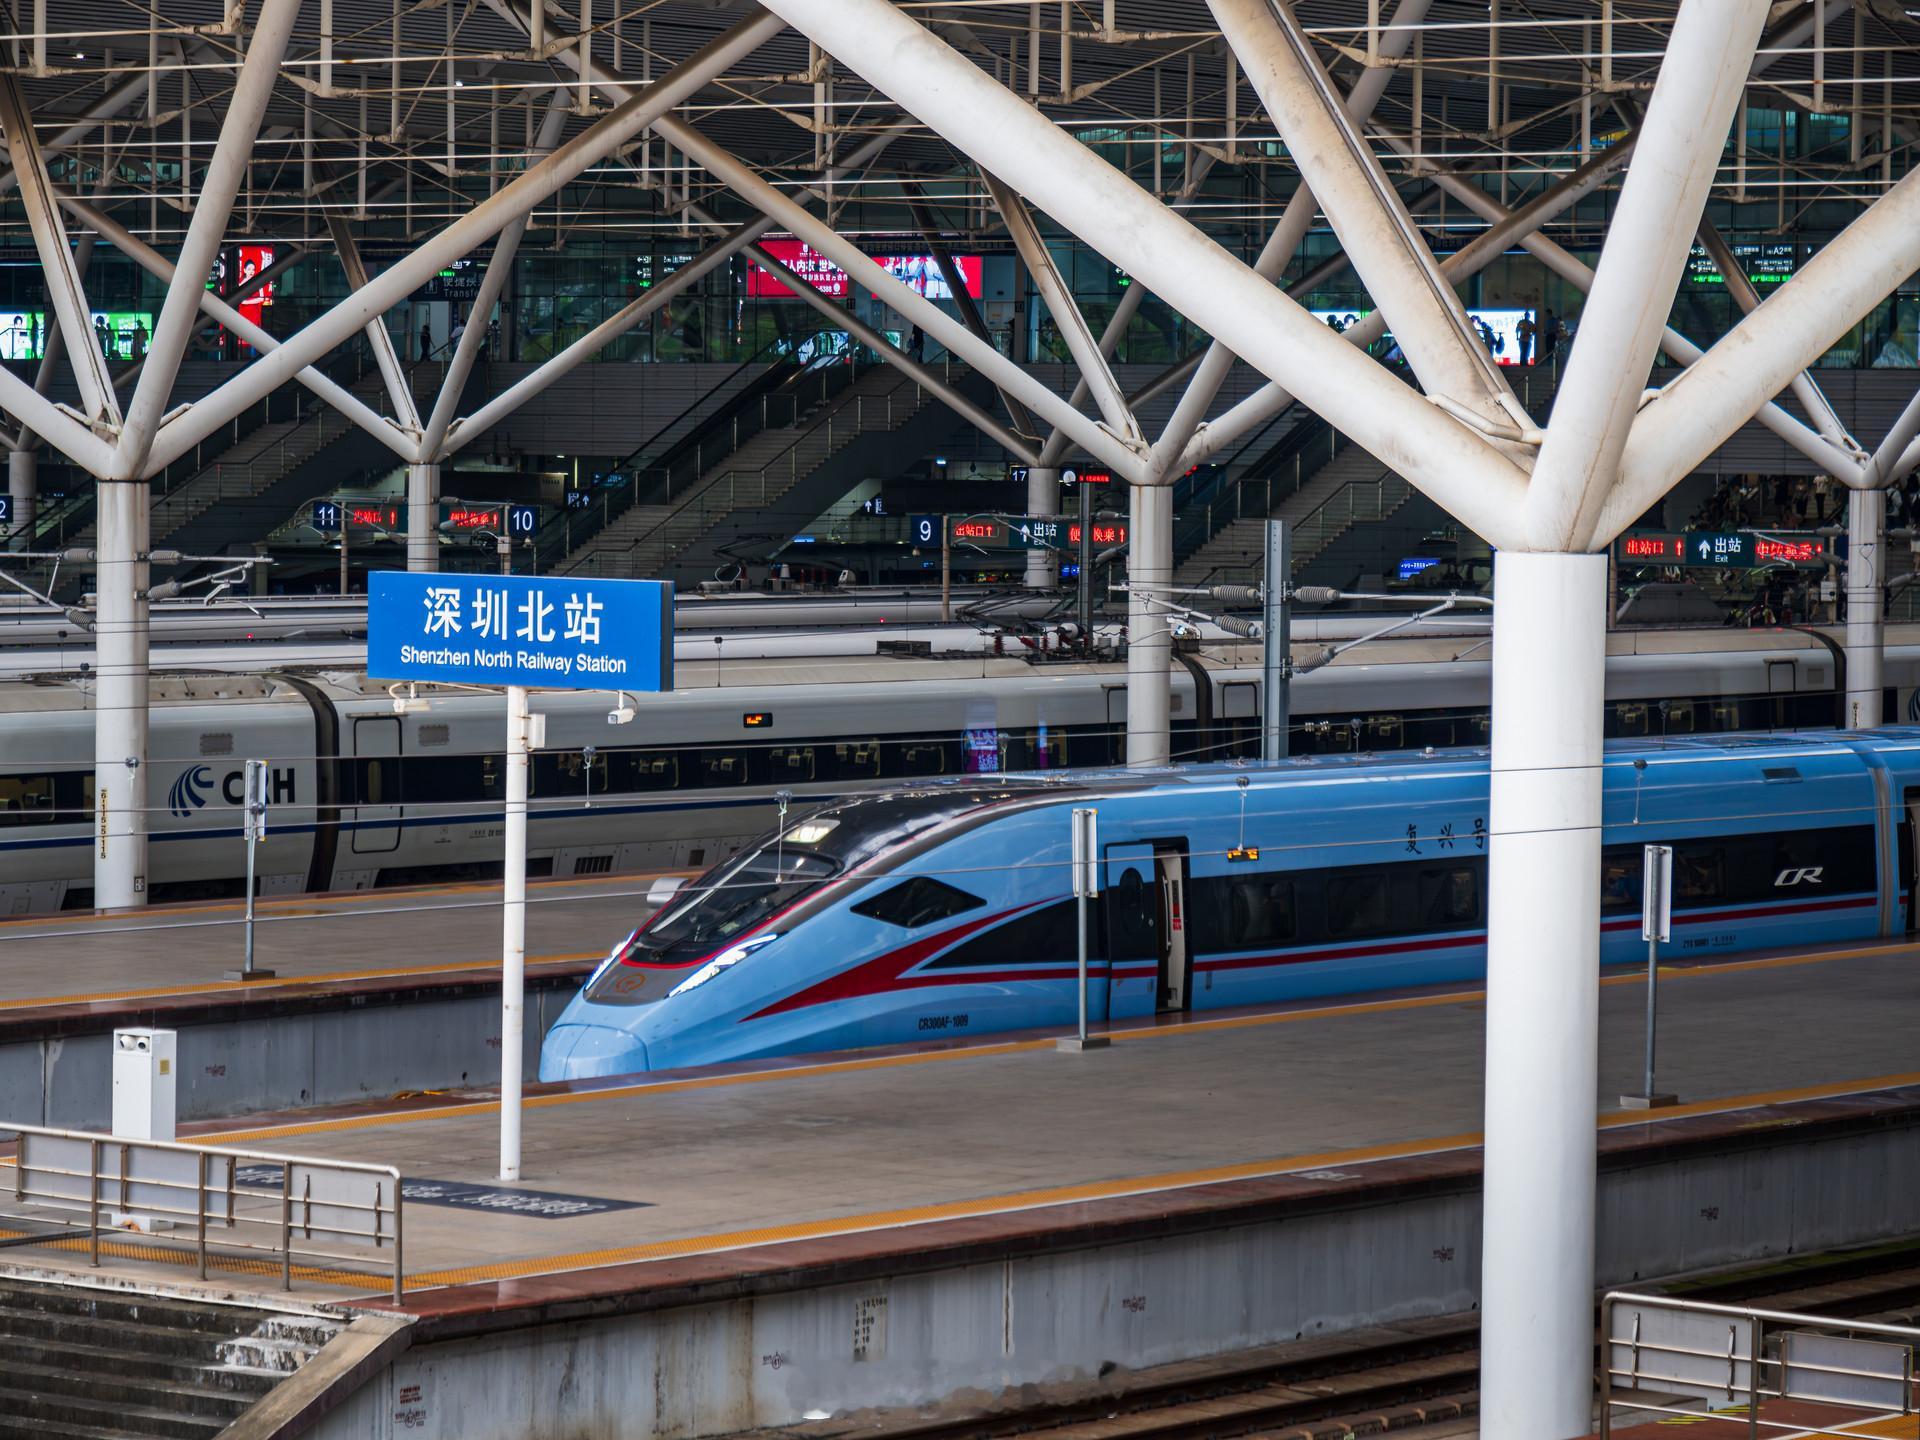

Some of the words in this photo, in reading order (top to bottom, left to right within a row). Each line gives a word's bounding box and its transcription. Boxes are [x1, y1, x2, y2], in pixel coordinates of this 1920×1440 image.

[1012, 470, 1027, 482] 17
[318, 506, 334, 526] 11
[513, 510, 533, 531] 10
[919, 520, 931, 541] 9
[955, 524, 984, 536] 出站口
[1033, 522, 1057, 537] 出站
[1626, 539, 1664, 555] 出站口
[1714, 537, 1742, 554] 出站
[1714, 555, 1728, 563] Exit
[423, 586, 604, 645] 深圳北站
[401, 645, 470, 666] Shenzhen
[475, 649, 512, 668] North
[516, 650, 573, 675] Railway
[576, 653, 627, 674] Station
[222, 767, 296, 805] CH
[1405, 817, 1487, 855] 复兴号
